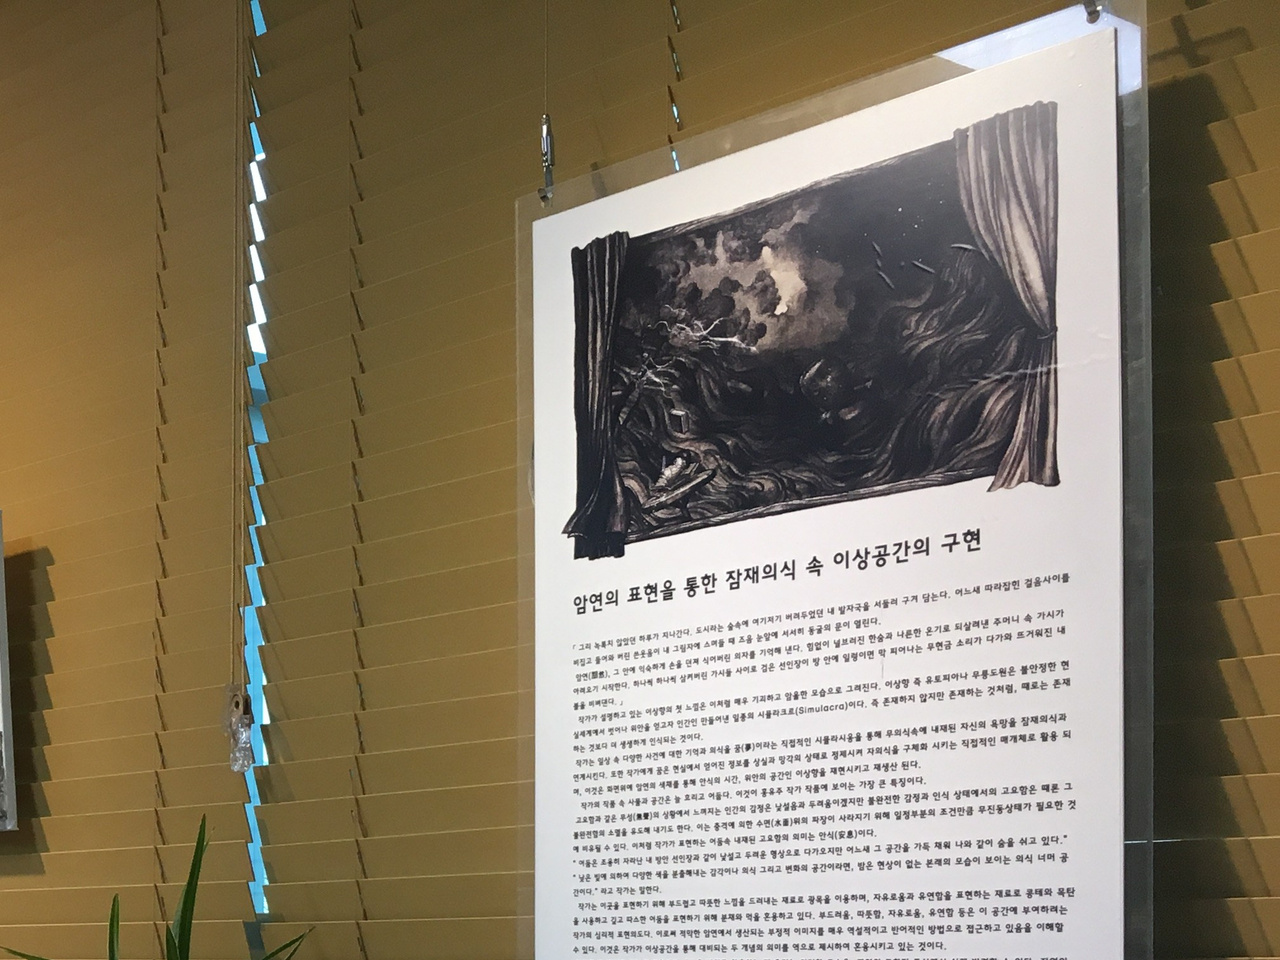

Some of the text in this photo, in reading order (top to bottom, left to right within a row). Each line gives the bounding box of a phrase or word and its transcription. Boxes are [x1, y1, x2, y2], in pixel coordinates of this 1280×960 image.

[573, 527, 981, 616] 암연의 표현을 통한 잠재의식 속 이상공간의 구현
[901, 572, 1071, 605] 구겨 담는다. 어느새 따라잡힌 걸음사이를
[896, 627, 922, 640] 나른한
[924, 624, 952, 637] 온기로
[954, 618, 990, 632] 되살려낸
[992, 614, 1020, 627] 주머니
[1023, 613, 1033, 624] 속
[1036, 608, 1065, 621] 가시가
[926, 625, 1066, 652] 무현금 소리가 다가와 뜨거워진 내
[912, 676, 922, 687] 즉
[924, 671, 969, 685] 유토피아나
[971, 665, 1017, 681] 무릉도원은
[1019, 661, 1057, 676] 불안정한
[1060, 659, 1070, 671] 현
[918, 677, 1071, 704] 않지만 존재하는 것처럼, 때로는 존재
[930, 722, 957, 734] 내재된
[959, 720, 987, 732] 자신의
[989, 716, 1018, 730] 욕망을
[1020, 712, 1068, 727] 잠재의식과
[902, 742, 929, 754] 구체화
[931, 740, 958, 751] 시키는
[961, 736, 996, 749] 직접적인
[1039, 730, 1059, 743] 활용
[1062, 729, 1072, 739] 되
[900, 759, 922, 771] 된다.
[903, 792, 930, 804] 감정과
[931, 790, 950, 802] 인식
[953, 787, 997, 801] 상태에서의
[1000, 784, 1038, 796] 고요함은
[1063, 782, 1073, 791] 그
[939, 799, 1077, 818] 조건만큼 무진동상태가 필요한 것
[913, 841, 931, 852] 가득
[933, 840, 952, 850] 채워
[954, 839, 973, 849] 나와
[975, 838, 994, 850] 같이
[996, 837, 1016, 849] 숨을
[1018, 836, 1038, 846] 쉬고
[904, 852, 1070, 870] 없는 본래의 모습이 보이는 의식 너머 공
[917, 886, 1076, 902] 유연함을 표현하는 재료로 콩테와 목탄
[928, 904, 1068, 918] 유연함 등은 이 공간에 부여하려는
[927, 921, 1065, 936] 방법으로 접근하고 있음을 이해할
[897, 941, 947, 952] 있는 것이다.
